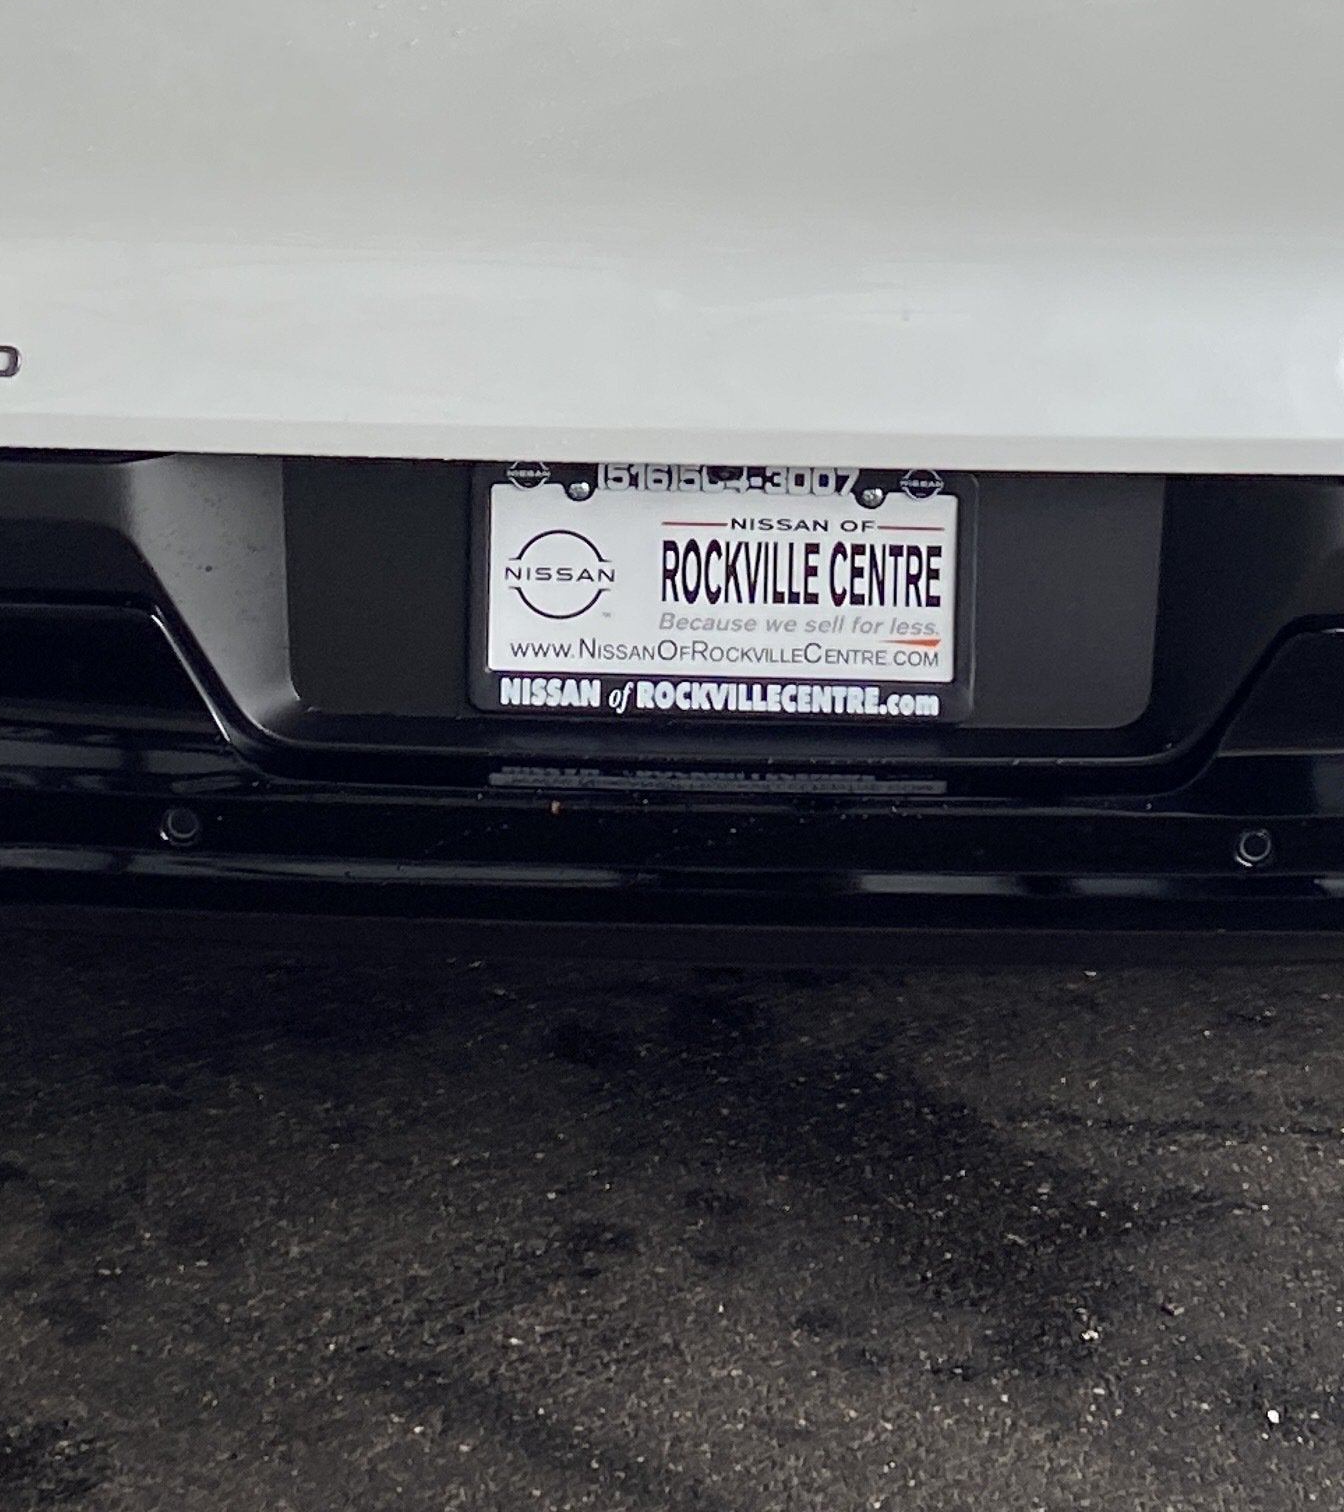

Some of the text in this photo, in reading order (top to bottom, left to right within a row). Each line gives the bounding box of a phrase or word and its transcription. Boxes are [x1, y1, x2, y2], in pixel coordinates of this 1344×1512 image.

[730, 517, 878, 533] NISSAN OF
[504, 566, 616, 584] NISSAN
[660, 537, 943, 608] ROCKVILLE CENTRE
[658, 611, 941, 637] Because we sell for less.
[499, 677, 941, 717] NISSAN of ROCKVILLECENTRE.com
